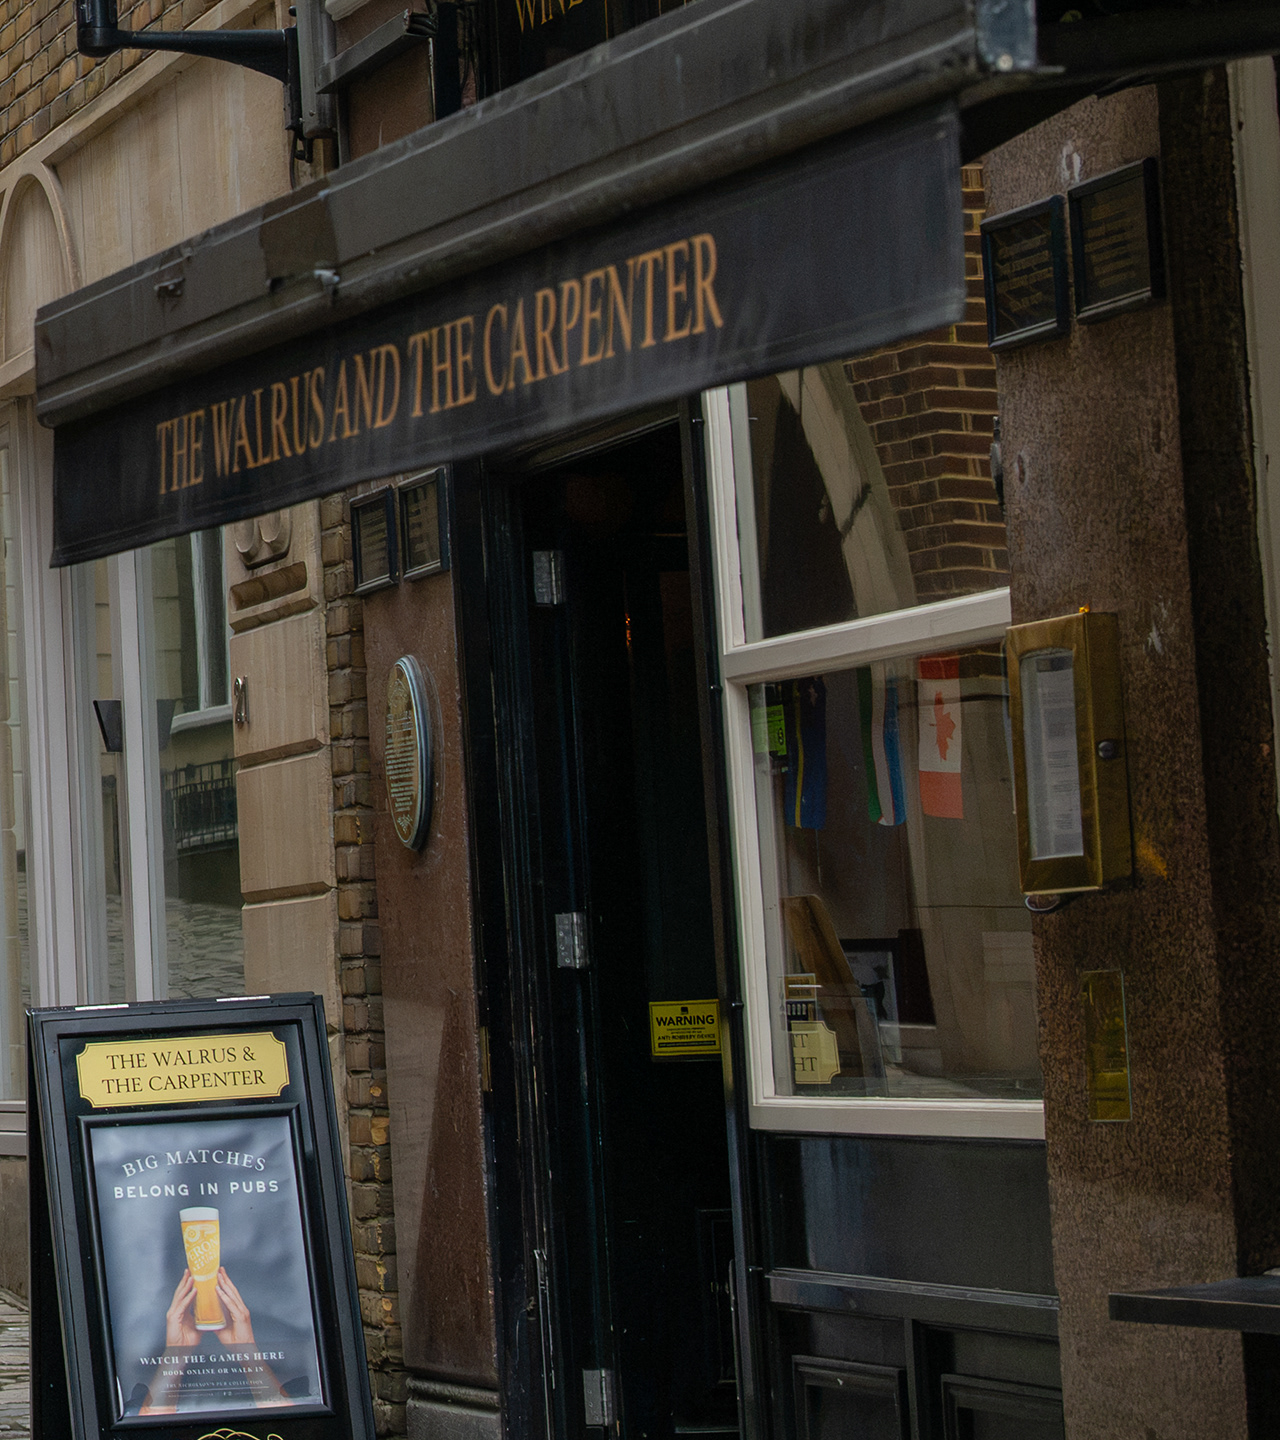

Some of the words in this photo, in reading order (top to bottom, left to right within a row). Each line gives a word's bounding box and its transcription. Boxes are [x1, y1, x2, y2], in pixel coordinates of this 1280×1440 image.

[156, 412, 204, 496] THE
[209, 366, 326, 480] WALRUS
[327, 342, 402, 444] AND
[407, 315, 478, 419] THE
[483, 232, 725, 397] CARPENTER
[656, 1015, 715, 1027] WARNING
[106, 1053, 148, 1070] THE
[152, 1047, 237, 1067] WALRUS
[242, 1046, 257, 1062] &
[101, 1077, 143, 1094] THE
[148, 1069, 267, 1092] CARPENTER
[122, 1155, 159, 1178] BIG
[165, 1149, 267, 1171] MATCHES
[113, 1183, 190, 1199] BELONG
[200, 1182, 219, 1196] IN
[230, 1180, 279, 1194] PUBS
[140, 1356, 180, 1366] WATCH
[183, 1354, 206, 1364] THE
[209, 1352, 250, 1363] GAMES
[253, 1351, 286, 1361] HERE
[187, 1368, 216, 1376] ONLINE
[231, 1366, 253, 1374] WALK
